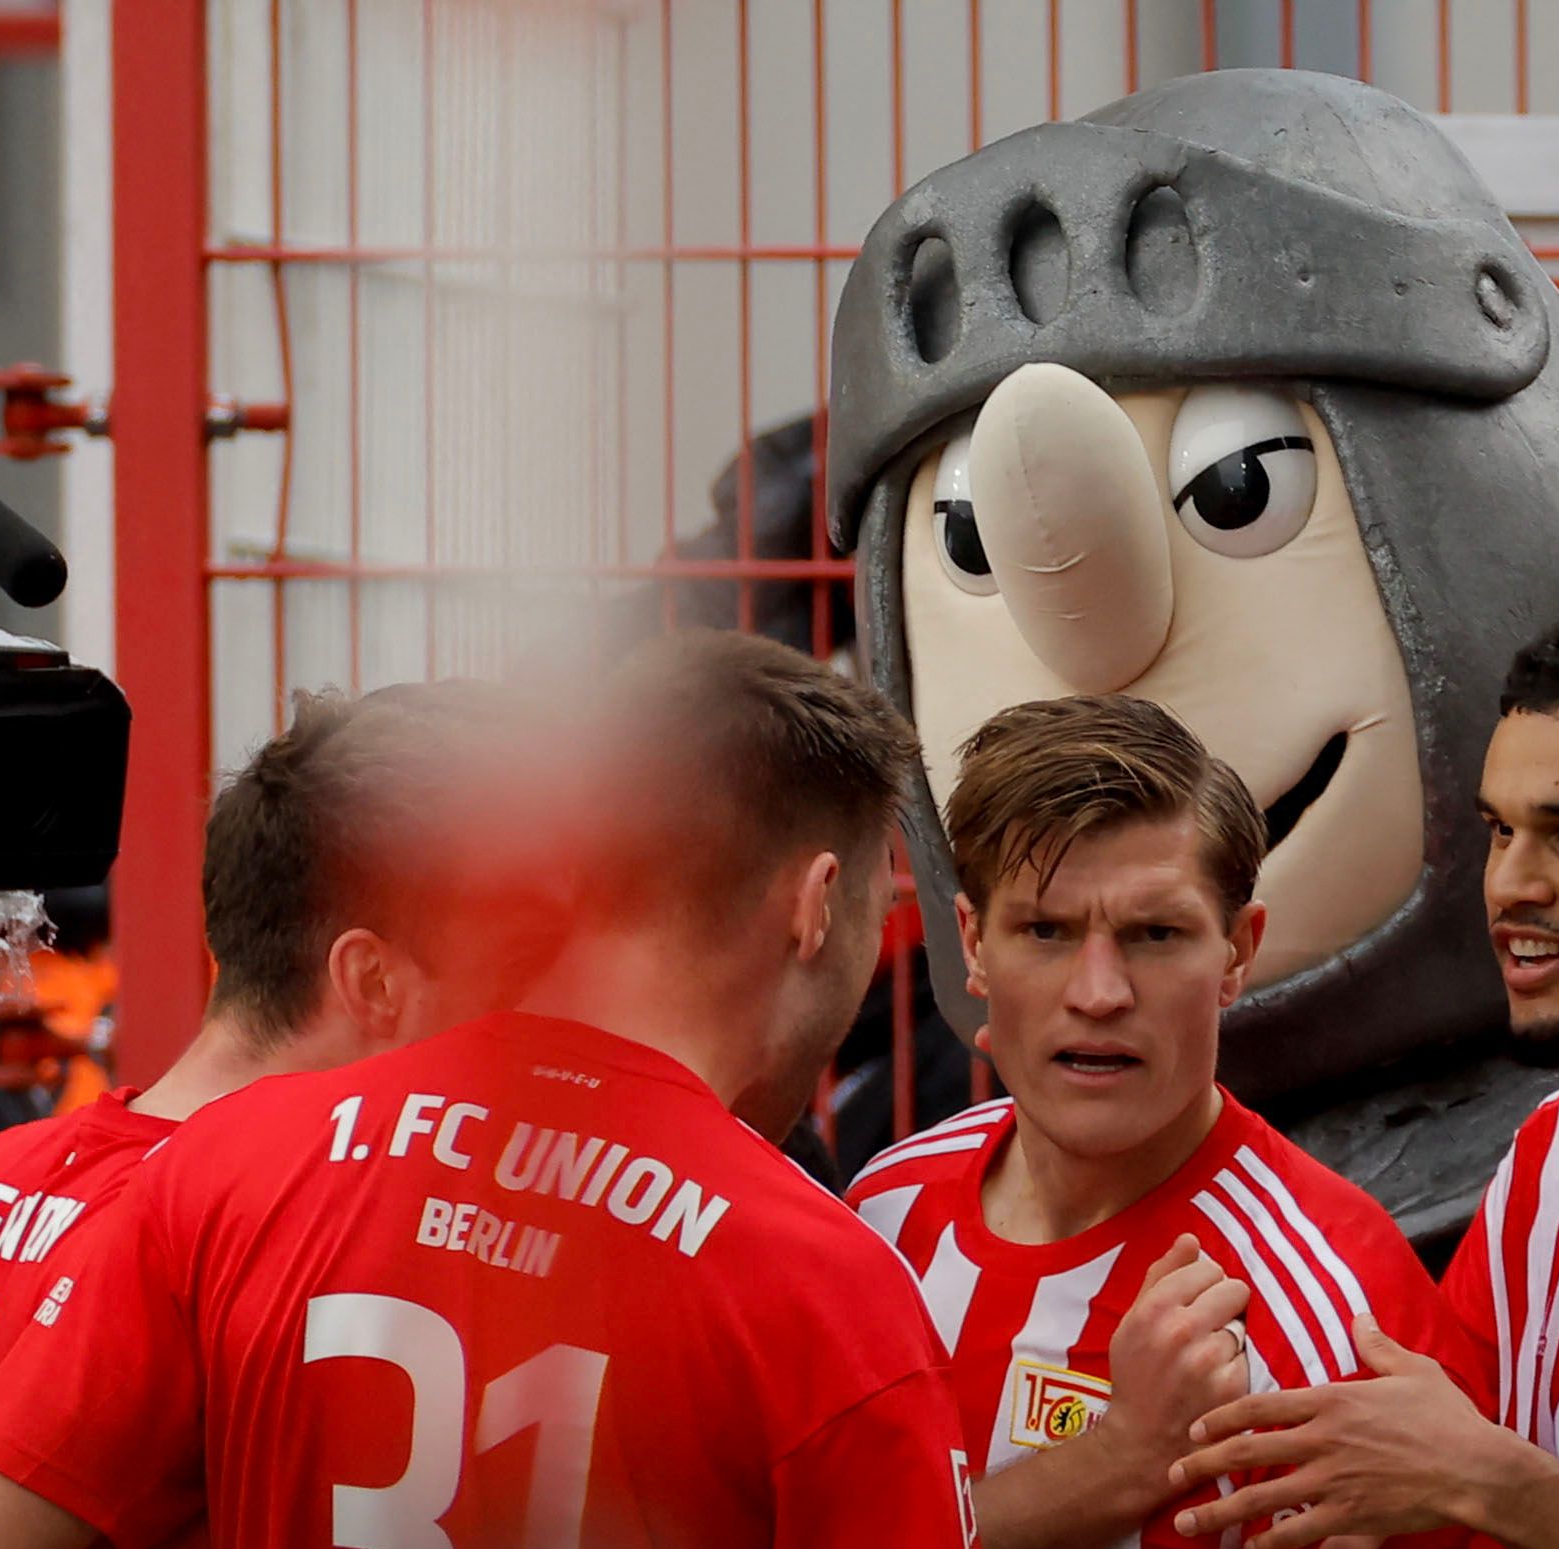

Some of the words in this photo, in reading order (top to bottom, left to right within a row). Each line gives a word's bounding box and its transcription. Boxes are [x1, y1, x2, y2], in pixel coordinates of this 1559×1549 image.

[329, 1096, 369, 1161] 1.
[389, 1093, 489, 1170] FC
[494, 1121, 731, 1258] UNION
[416, 1196, 561, 1277] BERLIN
